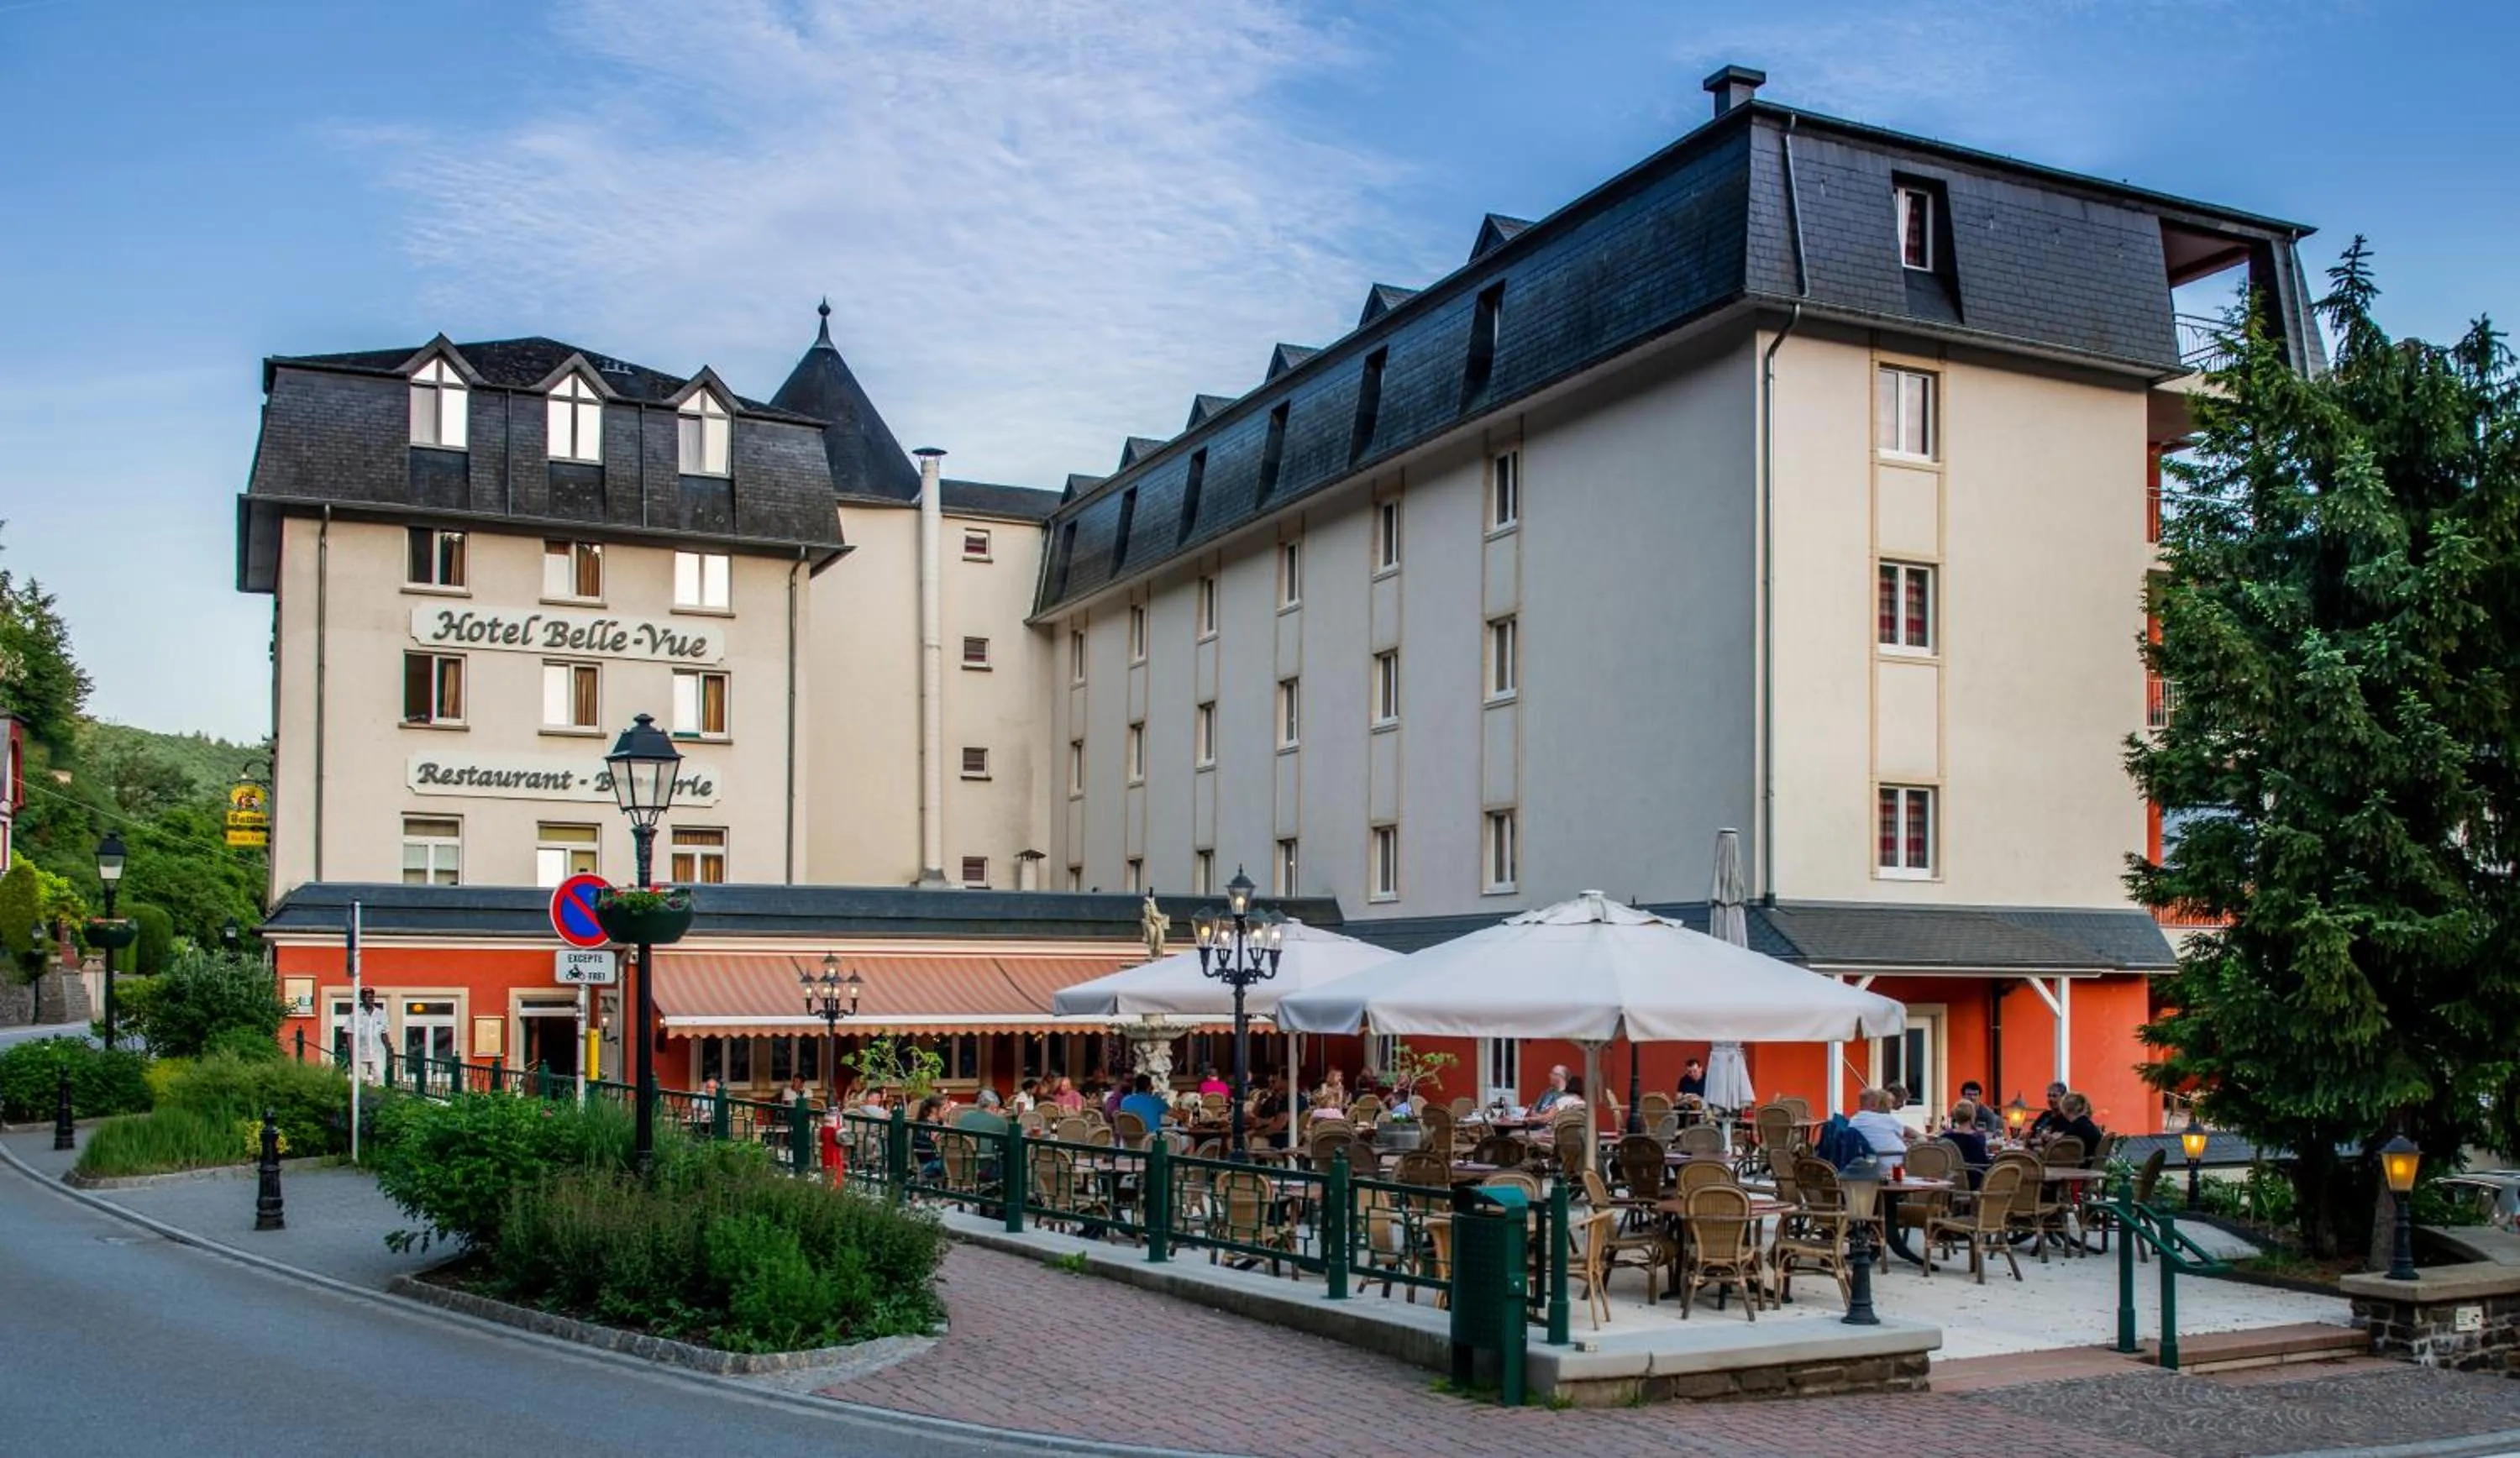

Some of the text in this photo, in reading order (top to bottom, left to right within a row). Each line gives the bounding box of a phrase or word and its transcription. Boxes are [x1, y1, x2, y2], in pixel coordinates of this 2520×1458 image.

[433, 611, 707, 658] Hotel Belle-Vue
[417, 763, 572, 790] Restaurant
